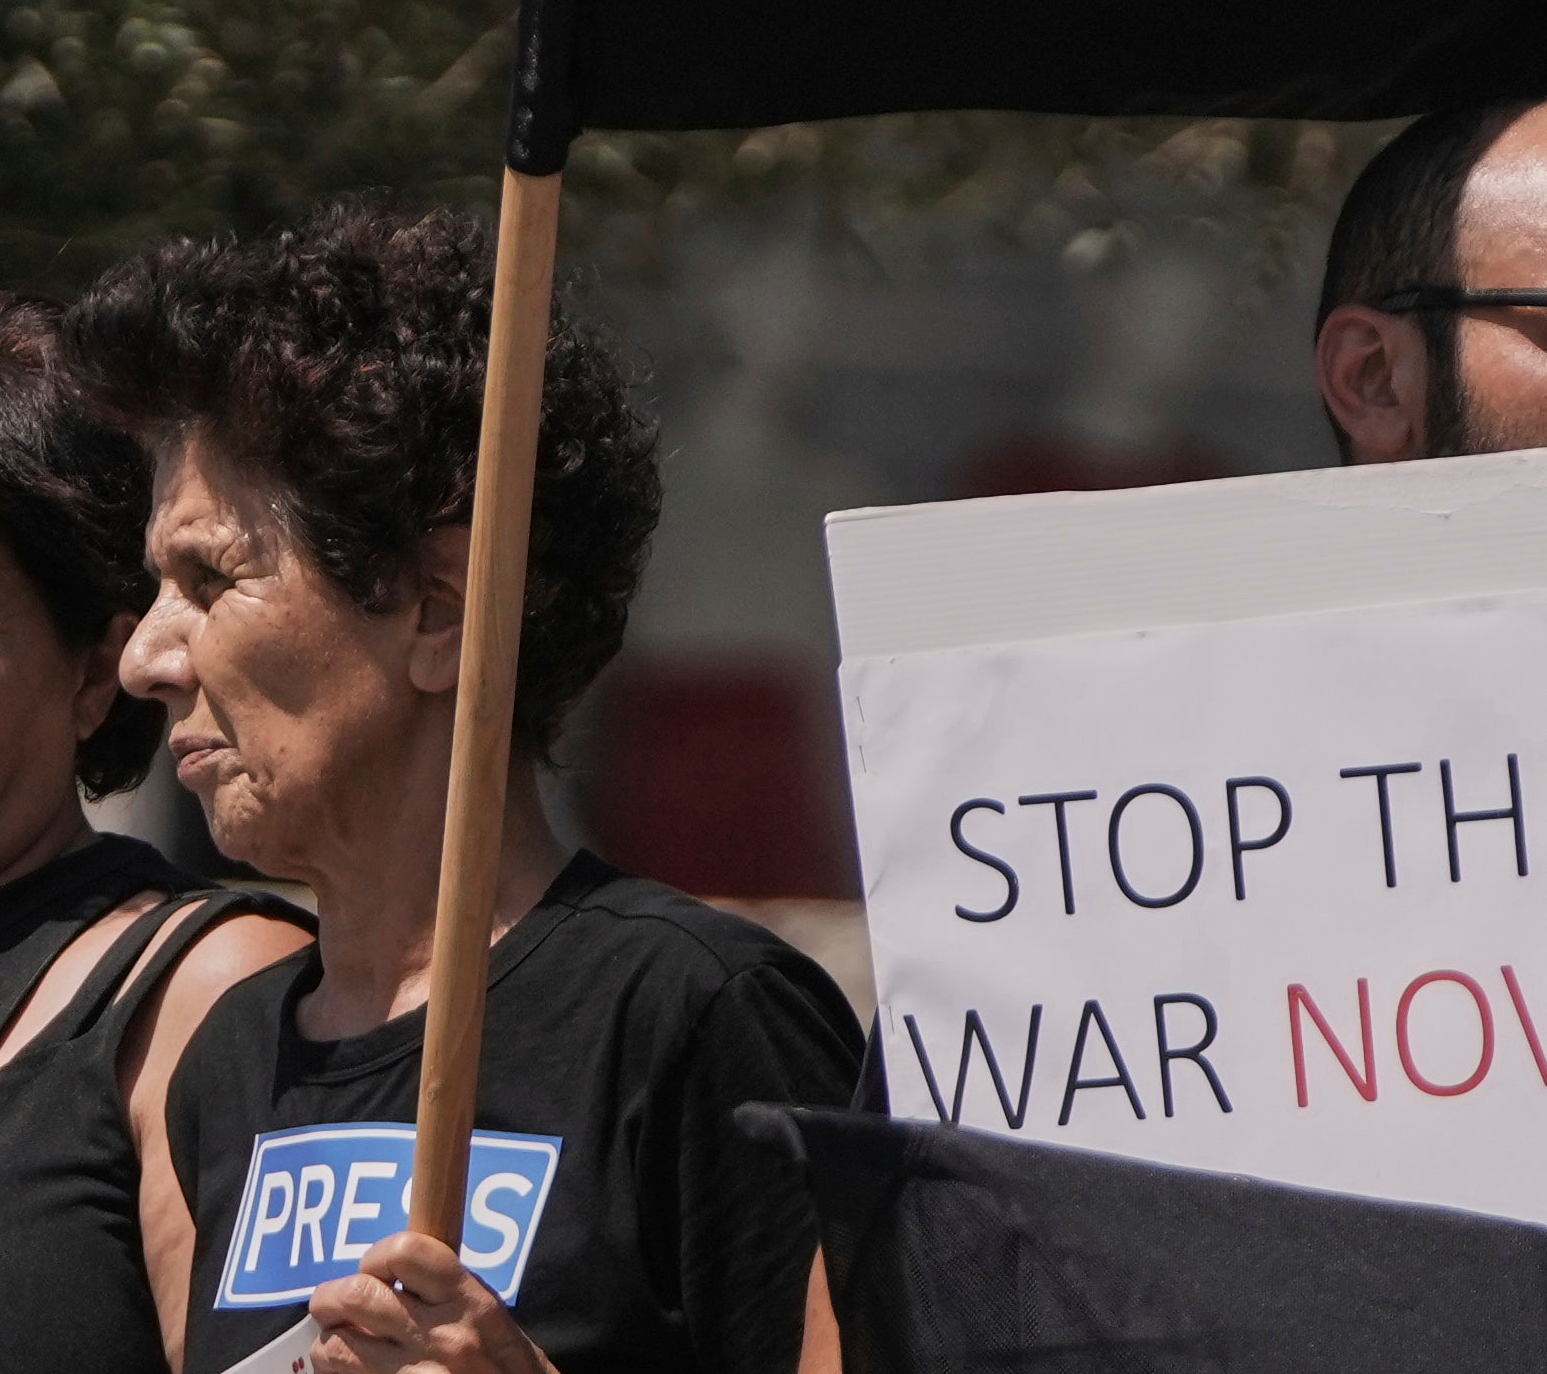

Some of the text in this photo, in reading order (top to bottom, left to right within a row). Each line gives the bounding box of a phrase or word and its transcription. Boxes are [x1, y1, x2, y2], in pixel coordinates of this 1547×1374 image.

[949, 775, 1293, 923] STOP
[902, 992, 1234, 1128] WAR
[244, 1161, 534, 1273] PRES
